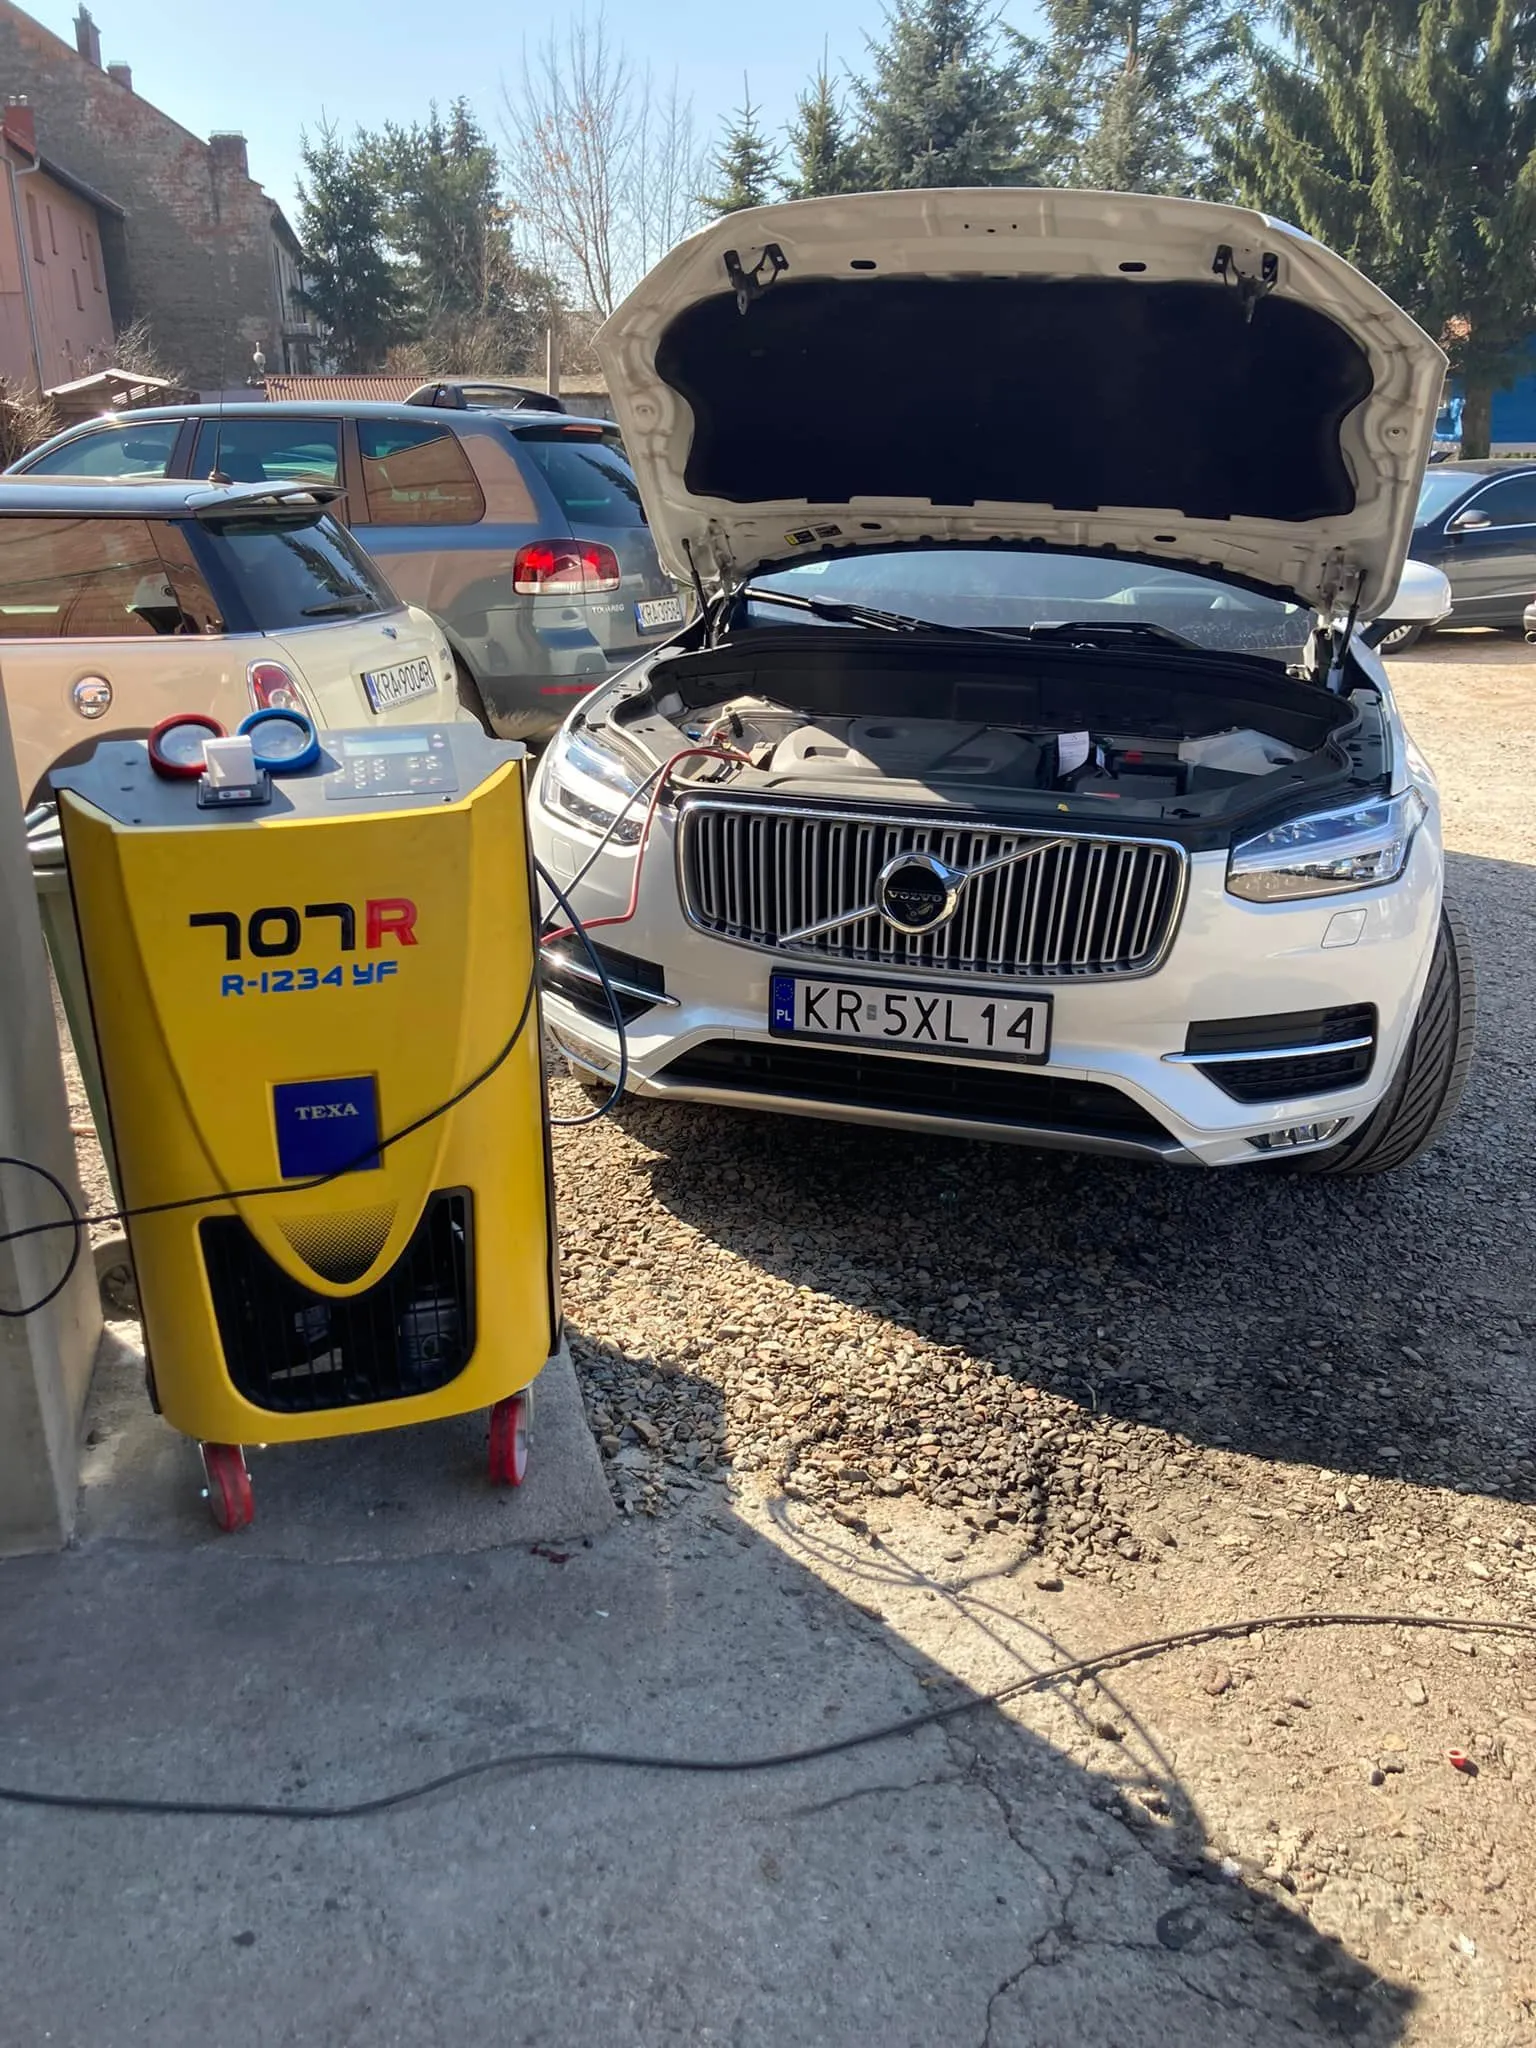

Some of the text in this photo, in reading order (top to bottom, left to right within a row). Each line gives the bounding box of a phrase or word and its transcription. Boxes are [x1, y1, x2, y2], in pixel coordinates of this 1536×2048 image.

[373, 660, 433, 702] KRA 9004R
[887, 889, 942, 902] VOLVO
[189, 898, 419, 961] 707R
[221, 960, 398, 997] R-1234 YF
[776, 1008, 791, 1022] PL
[804, 986, 862, 1033] KR
[294, 1102, 360, 1121] TEXA
